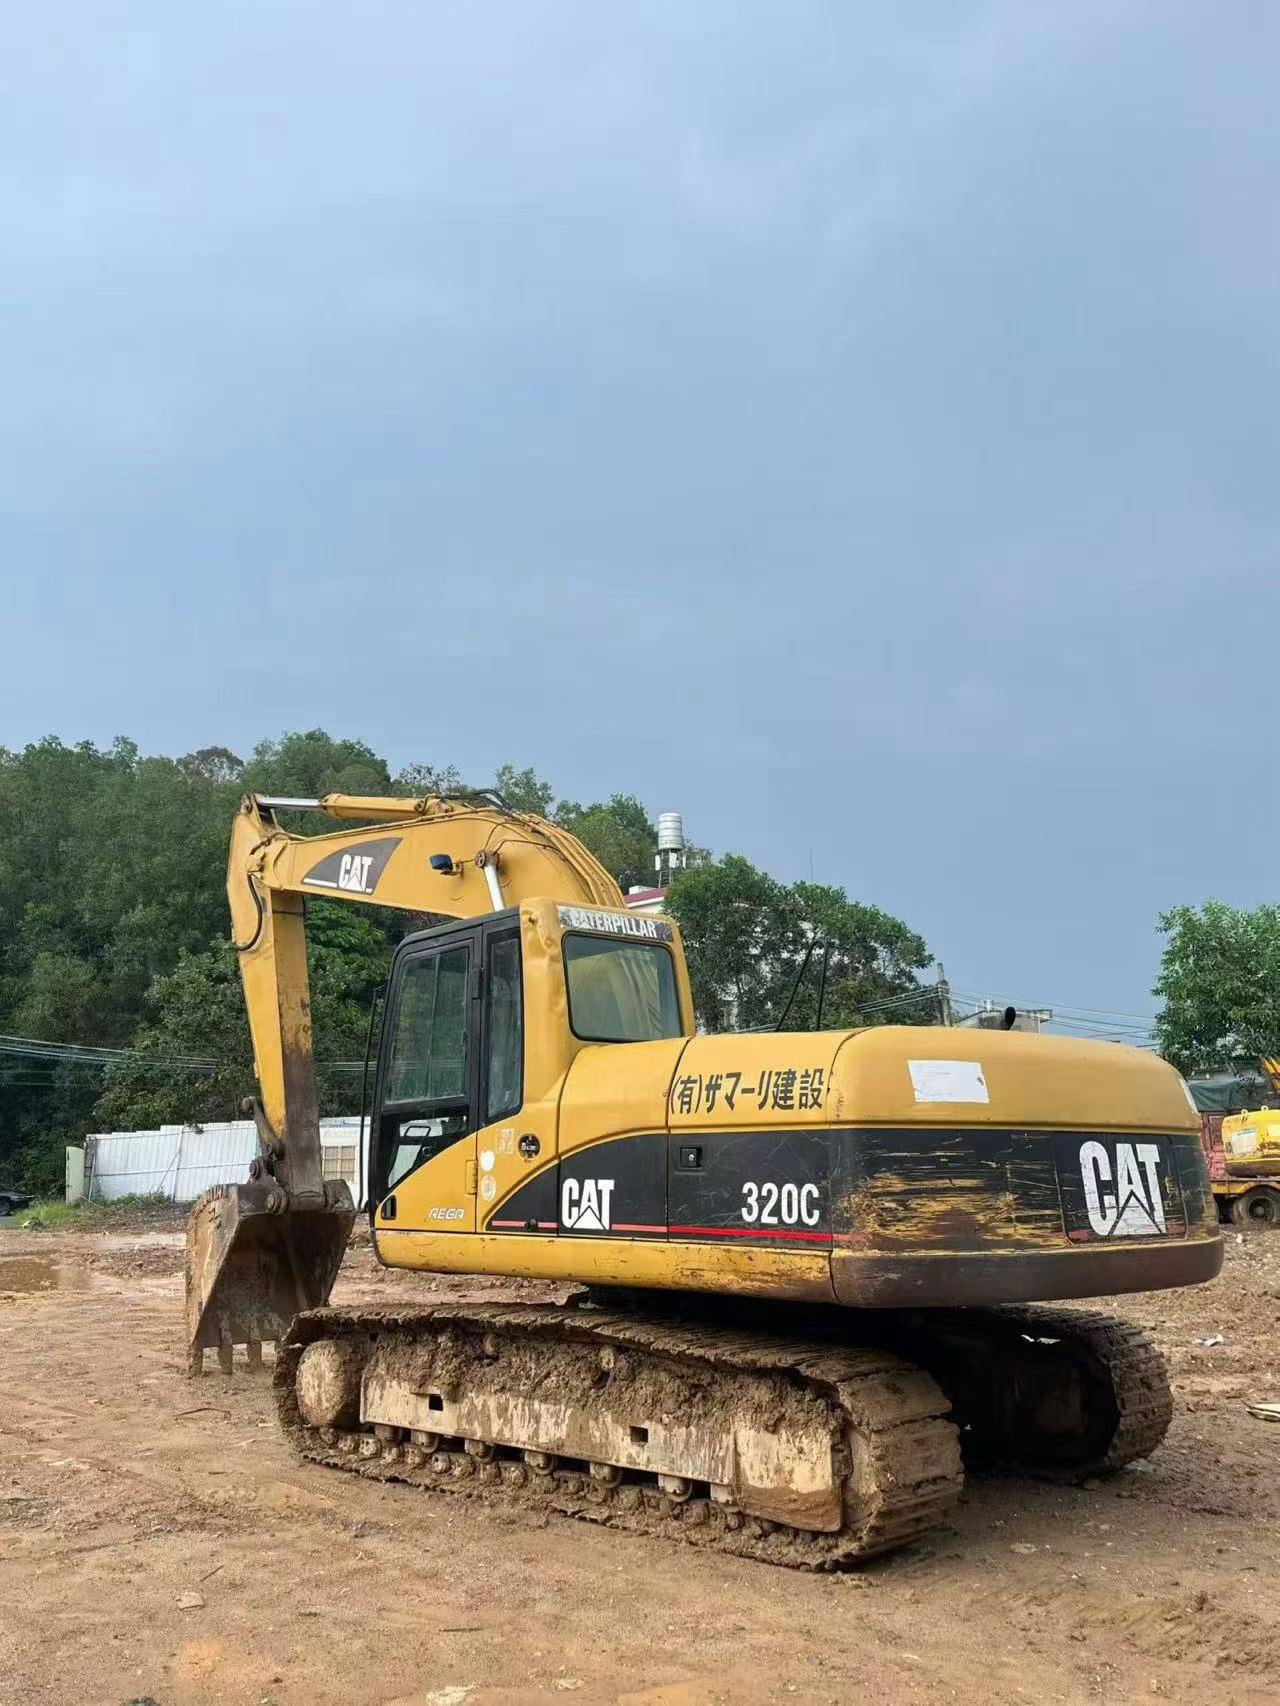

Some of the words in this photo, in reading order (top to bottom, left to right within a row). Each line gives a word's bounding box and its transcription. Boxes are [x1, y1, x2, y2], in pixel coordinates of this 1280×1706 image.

[339, 854, 374, 892] CAT
[568, 909, 658, 938] CATERPILLAR
[561, 1177, 615, 1231] CAT
[741, 1181, 820, 1226] 320C
[1079, 1140, 1167, 1237] CAT
